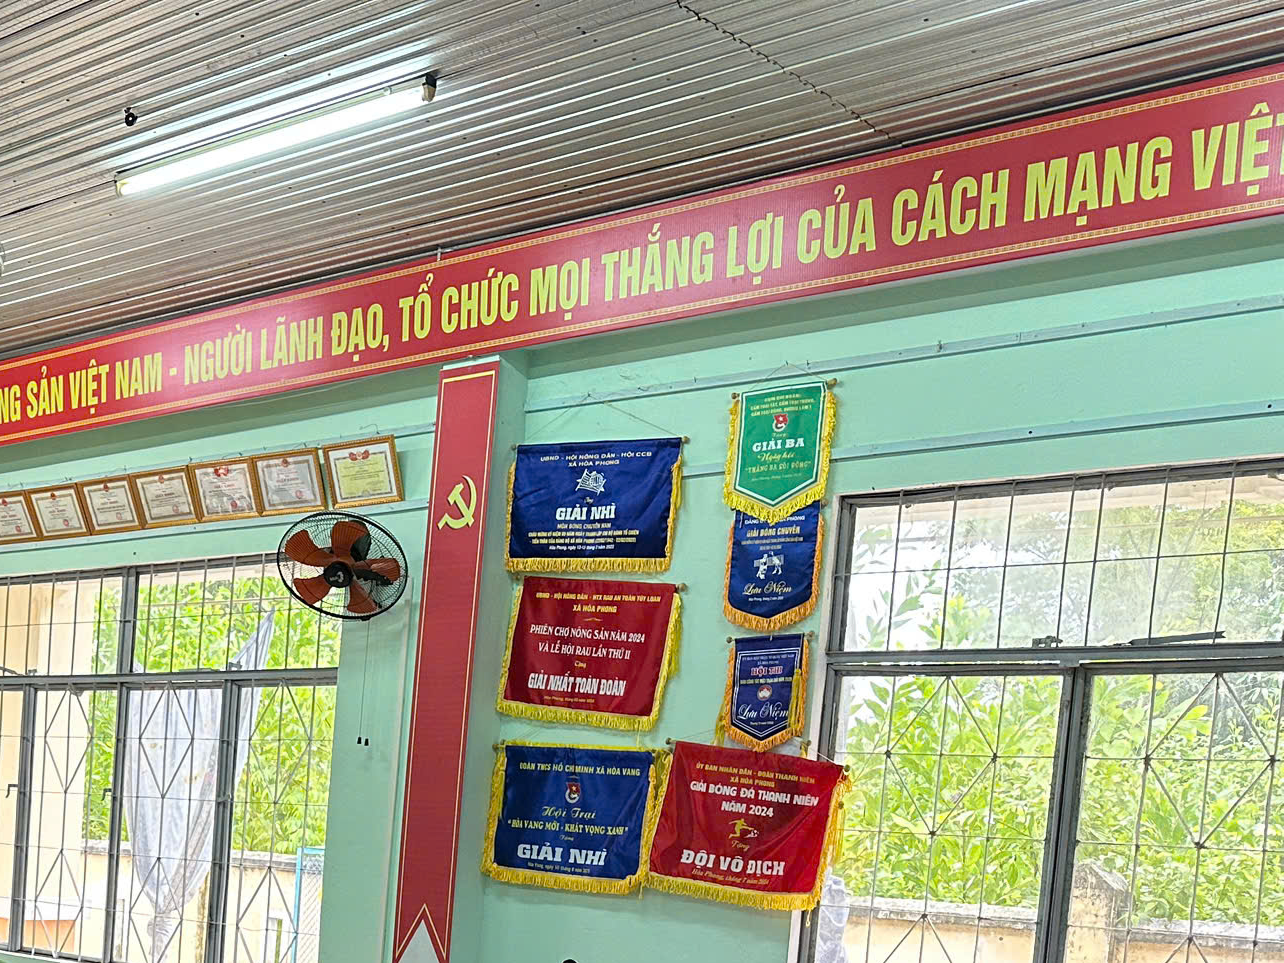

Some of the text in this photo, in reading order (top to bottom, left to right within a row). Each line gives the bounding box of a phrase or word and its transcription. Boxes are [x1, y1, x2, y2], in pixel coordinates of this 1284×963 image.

[26, 366, 64, 418] SẢN
[69, 361, 110, 415] VIỆT
[115, 352, 162, 400] NAM
[184, 324, 252, 386] NGƯỜI
[260, 313, 323, 371] LÃNH
[331, 303, 389, 362] ĐẠO,
[398, 273, 434, 342] TỔ
[440, 268, 519, 334] CHỨC
[529, 258, 590, 322] MỌI
[601, 222, 714, 302] THẮNG
[725, 212, 784, 285] LỢI
[796, 184, 876, 264] CỦA
[891, 168, 1010, 246] CÁCH
[1023, 135, 1173, 226] MẠNG
[785, 438, 805, 449] BA
[556, 503, 616, 520] GIẢI NHÌ
[530, 624, 645, 643] PHIÊN CHỢ NÔNG SẢN NĂM 2024
[539, 642, 549, 652] VÀ
[561, 642, 575, 656] HỘI
[576, 645, 591, 656] RAU
[609, 647, 625, 659] THỨ
[528, 670, 626, 696] GIẢI NHẤT TOÀN ĐOÀN
[623, 768, 641, 776] VANG
[705, 764, 718, 772] BAN
[775, 772, 798, 782] THANH
[690, 780, 819, 807] GIẢI BÓNG ĐÁ THANH NIÊN
[541, 806, 596, 820] Hội Trại
[721, 800, 774, 818] NĂM 2024
[517, 842, 608, 866] GIẢI NHÌ
[681, 849, 786, 877] ĐỘI VÔ ĐỊCH
